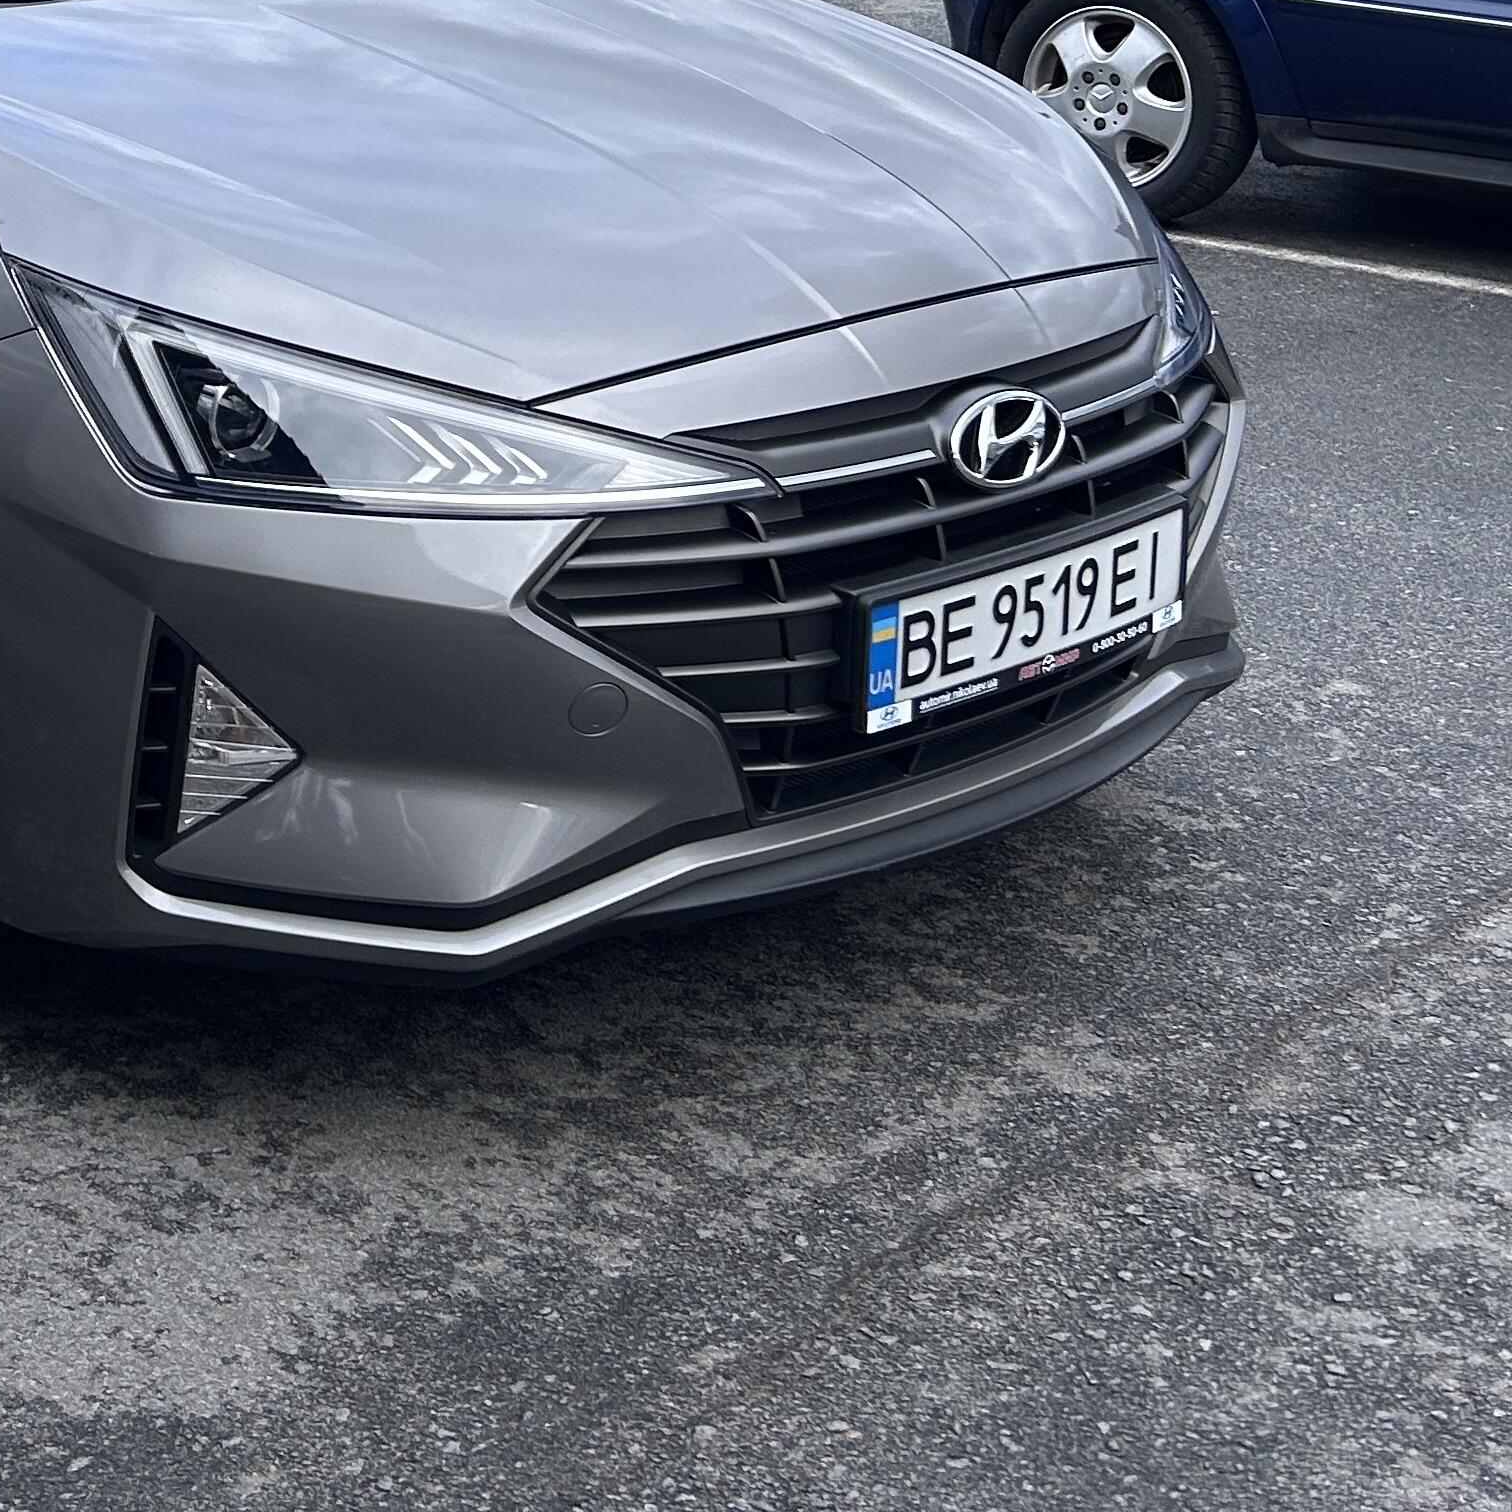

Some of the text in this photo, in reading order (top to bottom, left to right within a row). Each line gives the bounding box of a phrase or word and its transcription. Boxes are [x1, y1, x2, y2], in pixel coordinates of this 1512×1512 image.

[900, 531, 1159, 689] BE 9519 EI
[869, 673, 893, 695] UA
